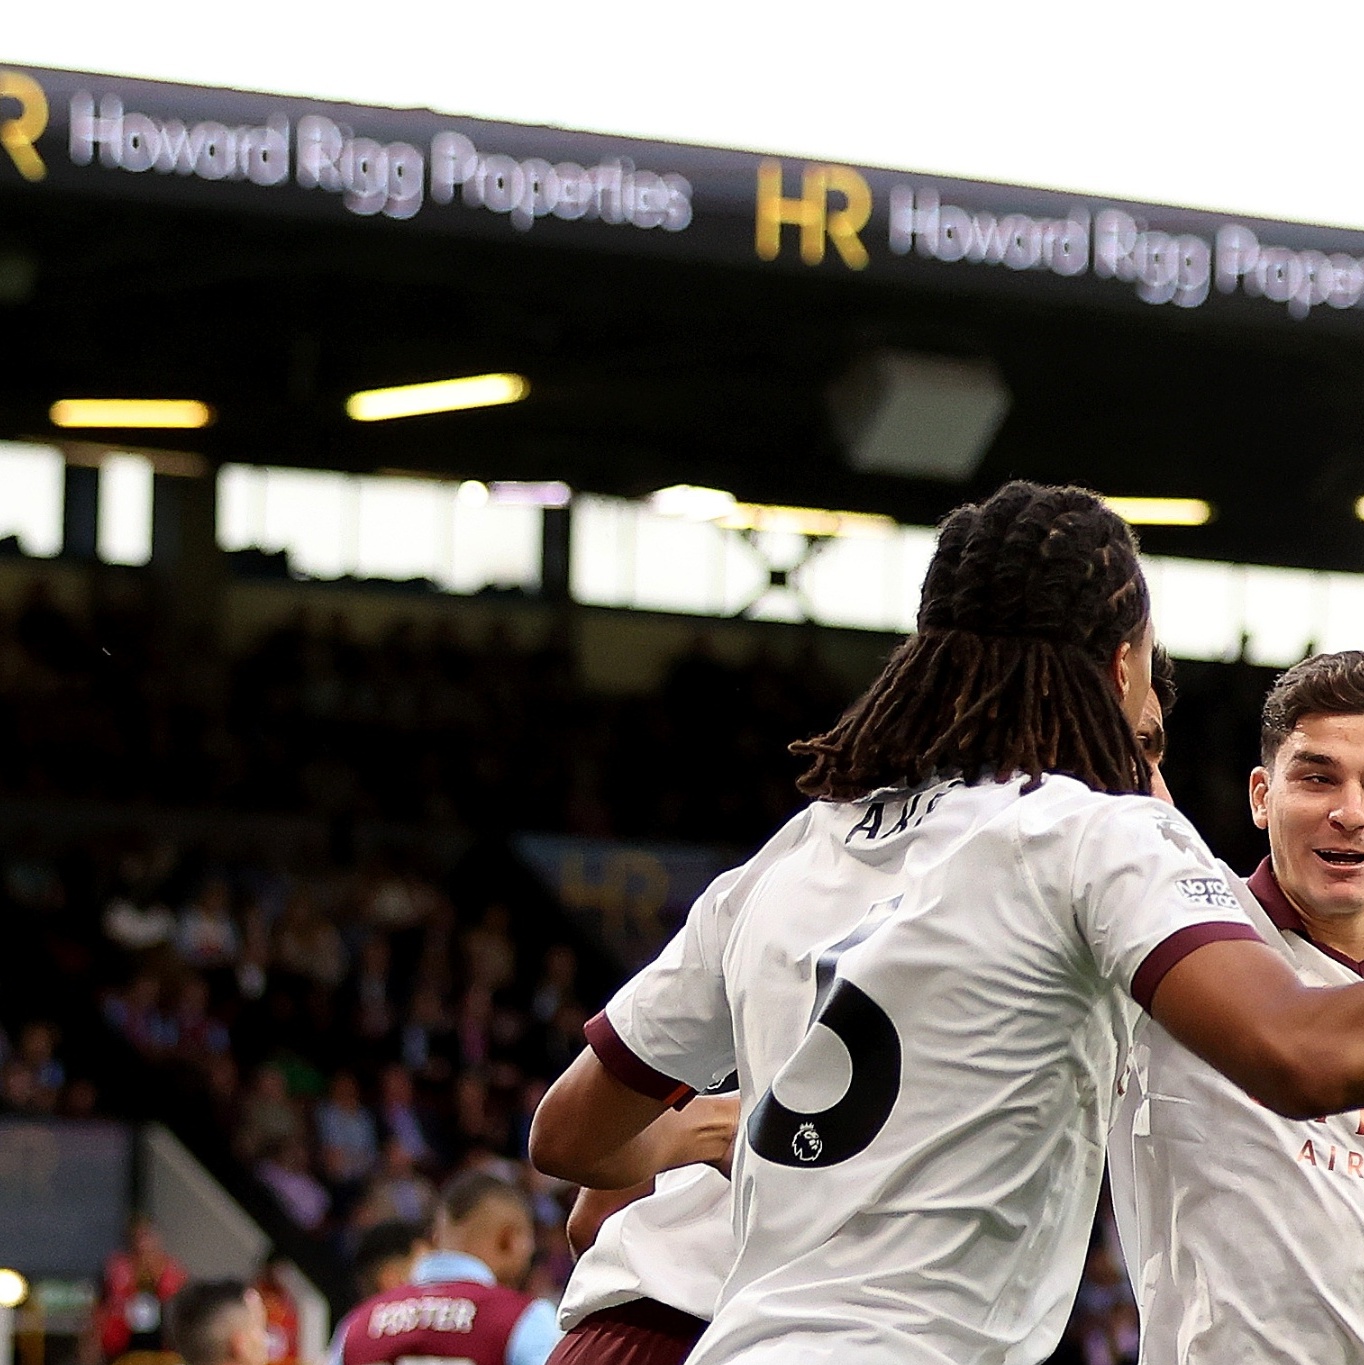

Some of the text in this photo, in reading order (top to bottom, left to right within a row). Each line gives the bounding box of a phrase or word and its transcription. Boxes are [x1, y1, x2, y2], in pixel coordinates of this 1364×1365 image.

[68, 90, 694, 232] Howard Rigg Properties
[755, 160, 872, 271] HR
[889, 184, 1090, 277] Howard
[1094, 208, 1211, 309] Rigg
[747, 896, 902, 1168] 6
